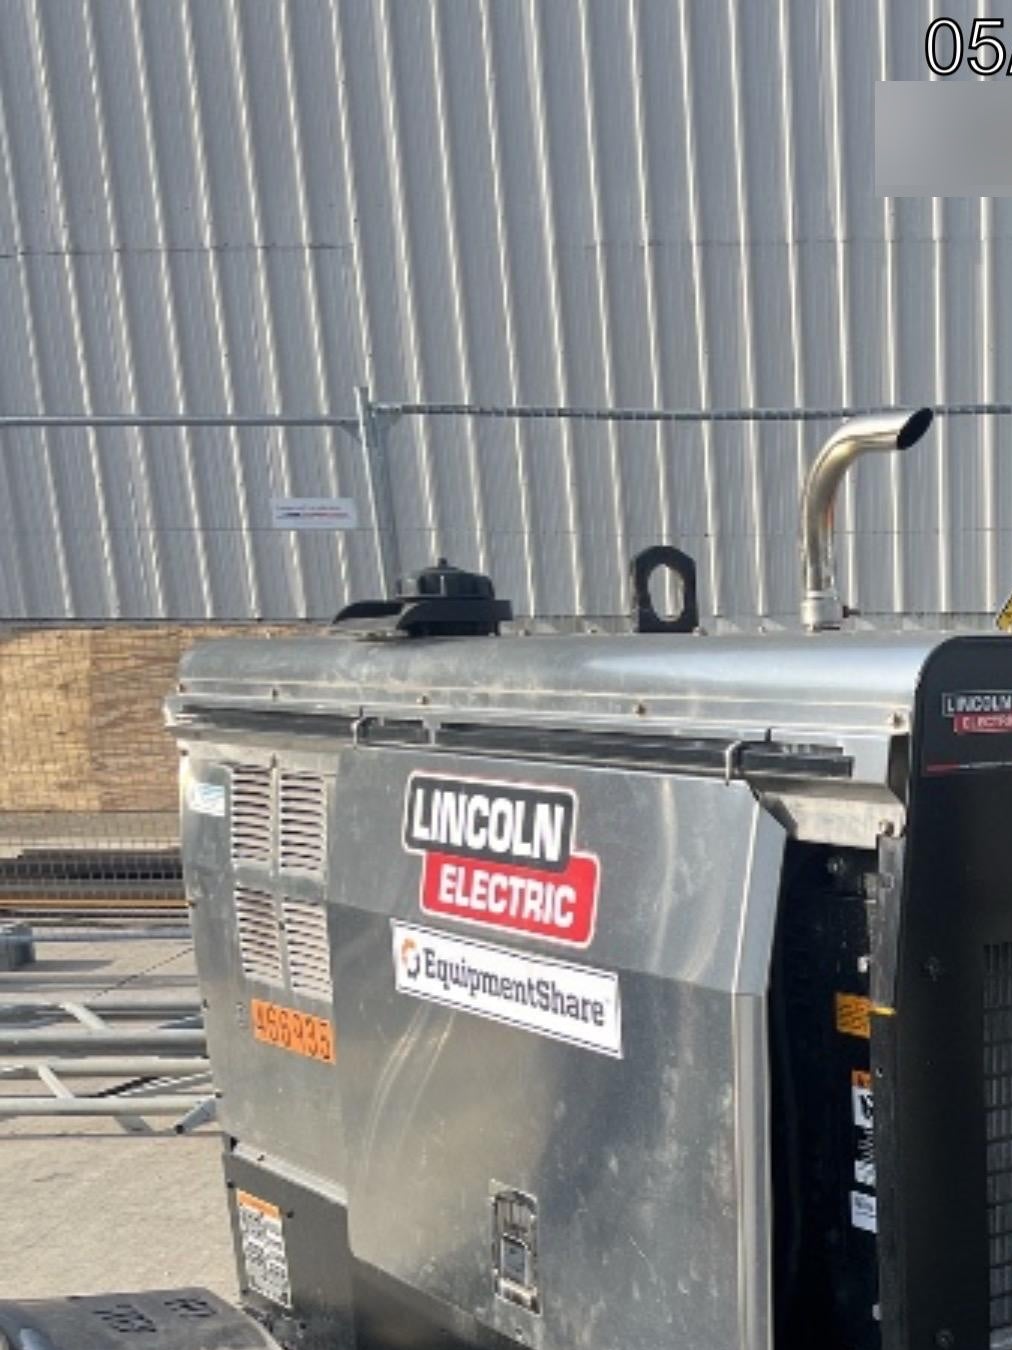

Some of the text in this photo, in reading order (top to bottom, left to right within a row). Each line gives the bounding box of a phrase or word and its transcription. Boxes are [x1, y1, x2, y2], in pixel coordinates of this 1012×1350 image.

[411, 787, 565, 862] LINCOLN
[437, 863, 577, 928] ELECTRIC
[422, 946, 605, 1027] EquipmentShare
